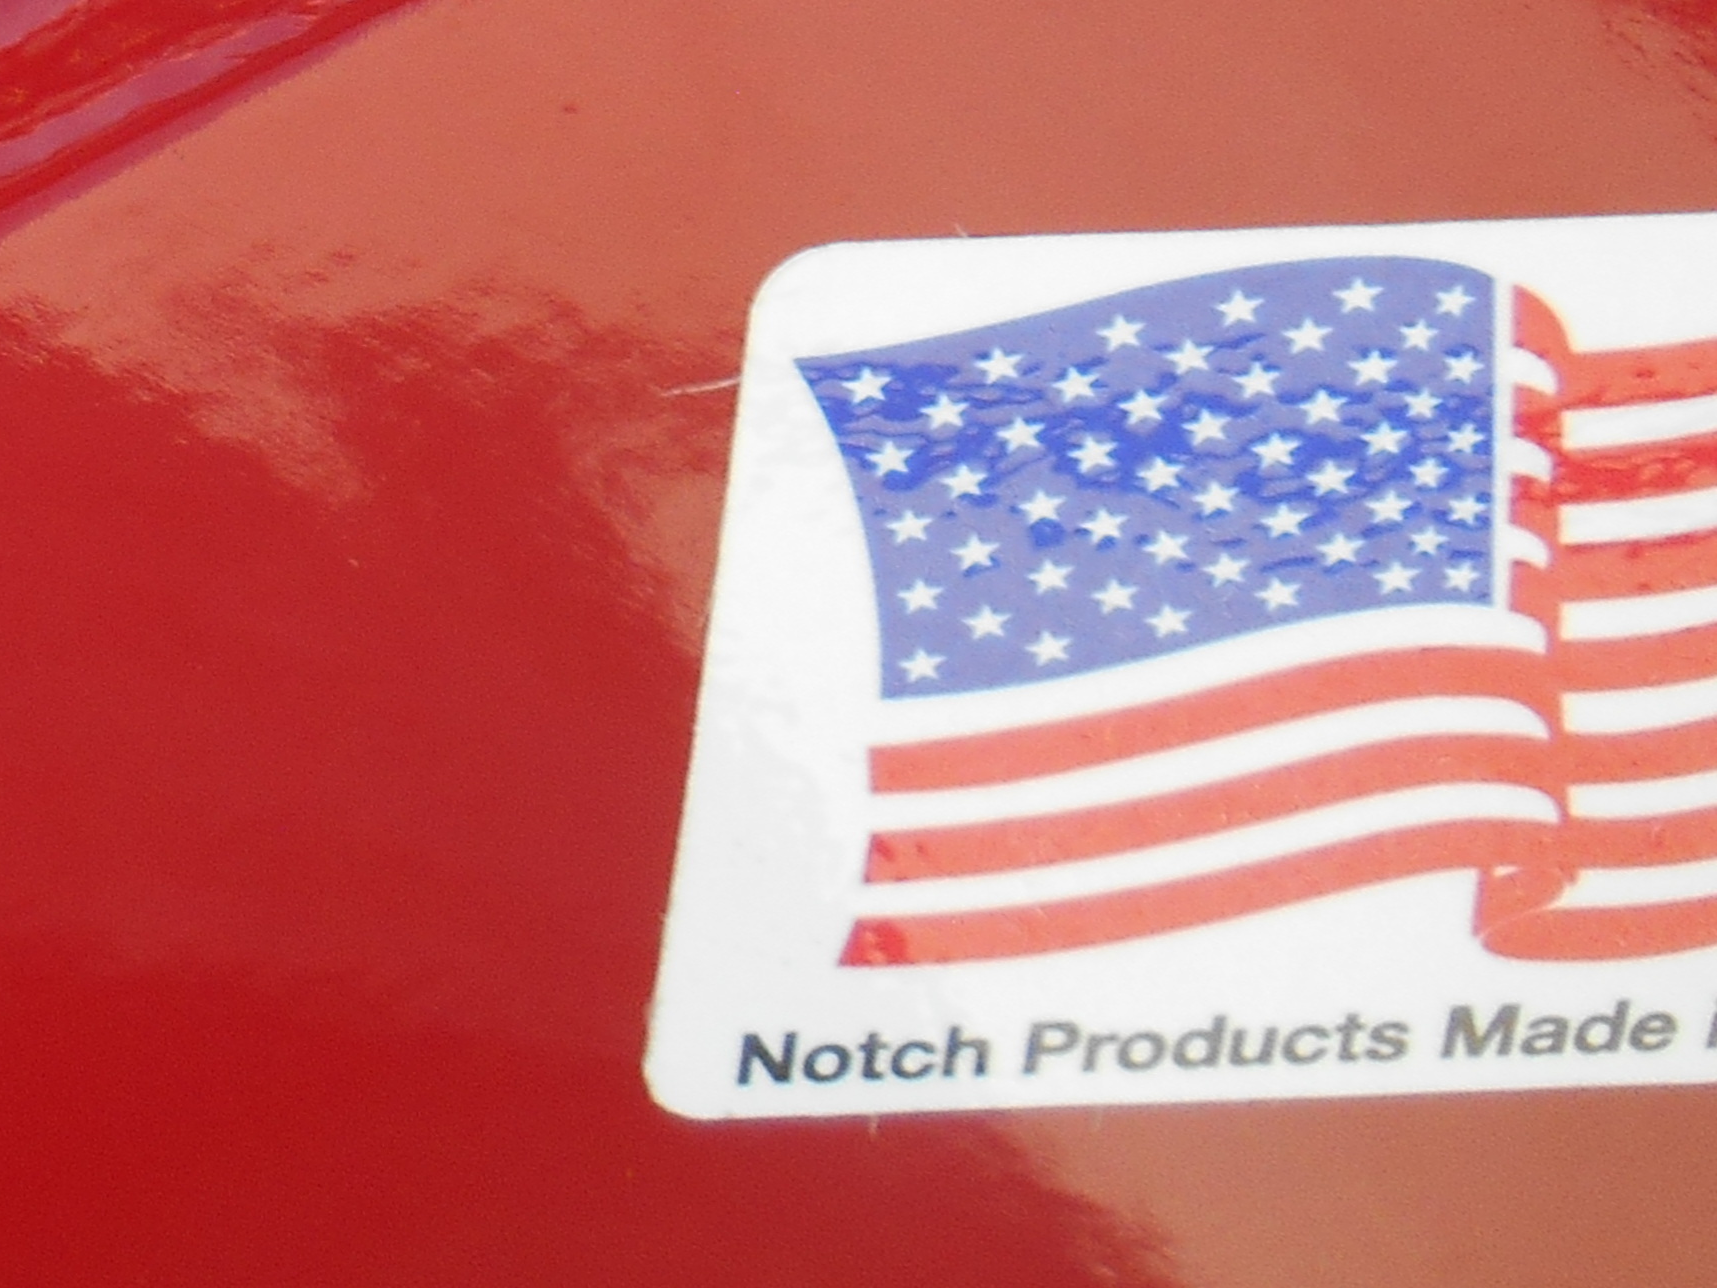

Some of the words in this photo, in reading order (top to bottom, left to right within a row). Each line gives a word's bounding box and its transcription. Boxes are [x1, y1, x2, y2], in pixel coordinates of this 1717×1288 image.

[736, 1025, 989, 1087] Notch
[1020, 1011, 1411, 1077] Products
[1439, 998, 1679, 1060] Made
